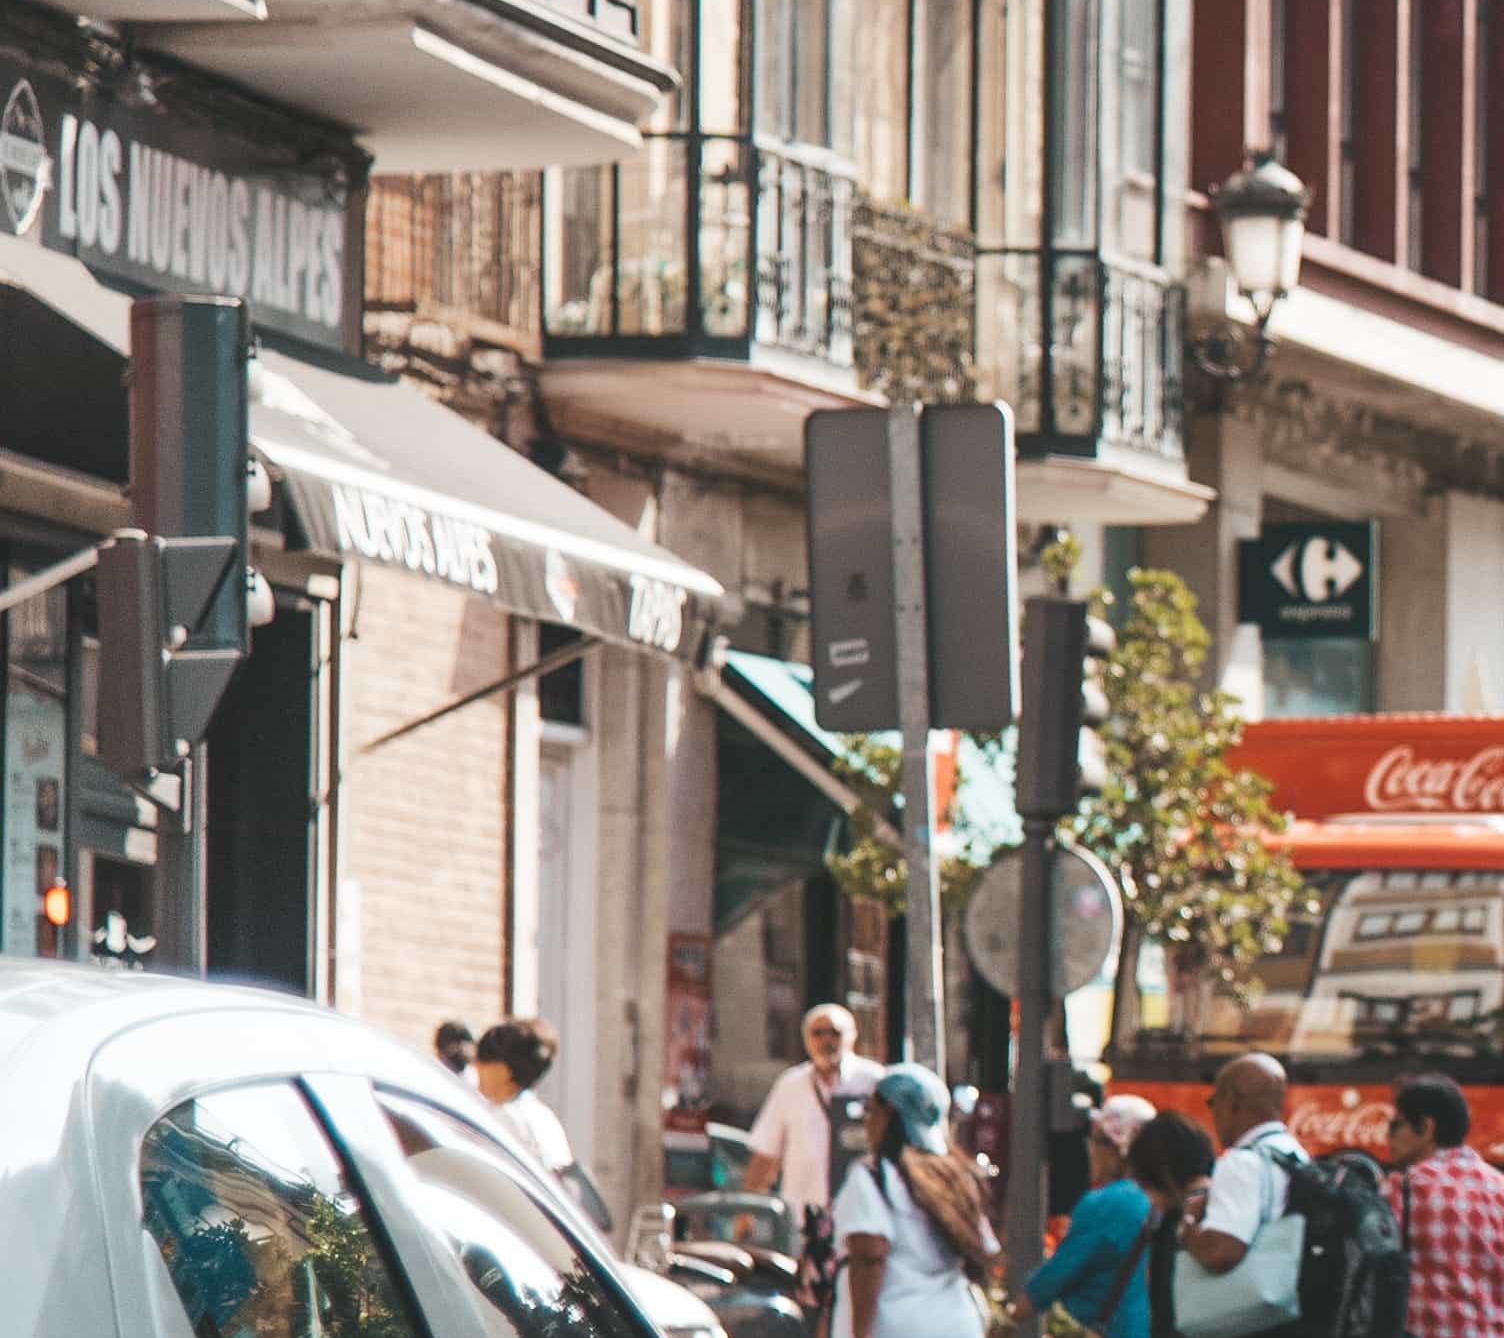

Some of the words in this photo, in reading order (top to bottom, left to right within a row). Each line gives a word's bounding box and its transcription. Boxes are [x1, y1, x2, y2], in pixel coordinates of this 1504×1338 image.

[59, 114, 122, 254] LOS
[127, 140, 250, 296] NUEVOS
[251, 187, 344, 328] ALPES
